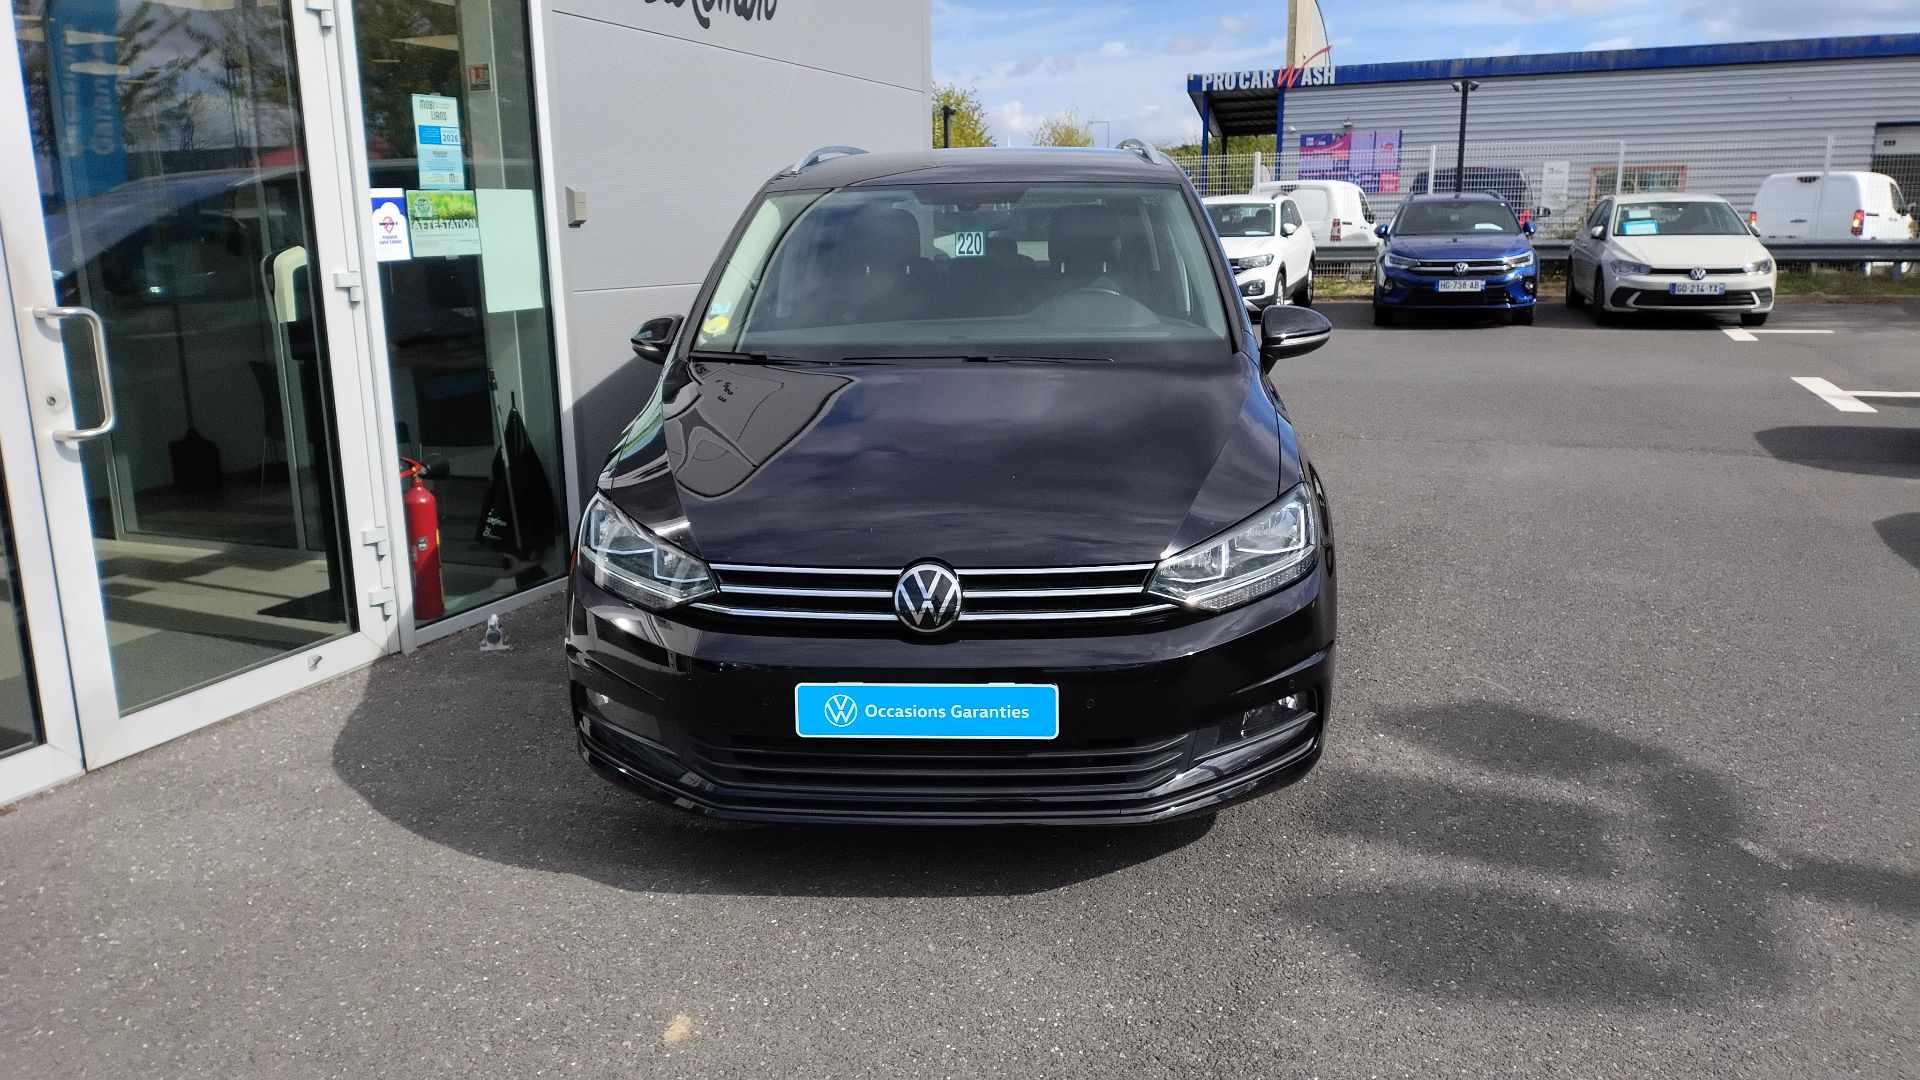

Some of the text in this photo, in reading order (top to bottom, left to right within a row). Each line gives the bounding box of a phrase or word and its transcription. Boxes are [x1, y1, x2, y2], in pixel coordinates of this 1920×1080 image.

[1202, 72, 1236, 91] PRO
[1239, 69, 1274, 89] CAR
[442, 135, 459, 143] 2026
[413, 219, 477, 231] ATTESTATION
[957, 232, 982, 255] 220
[865, 704, 947, 719] Occasions
[950, 704, 1030, 719] Garanties
